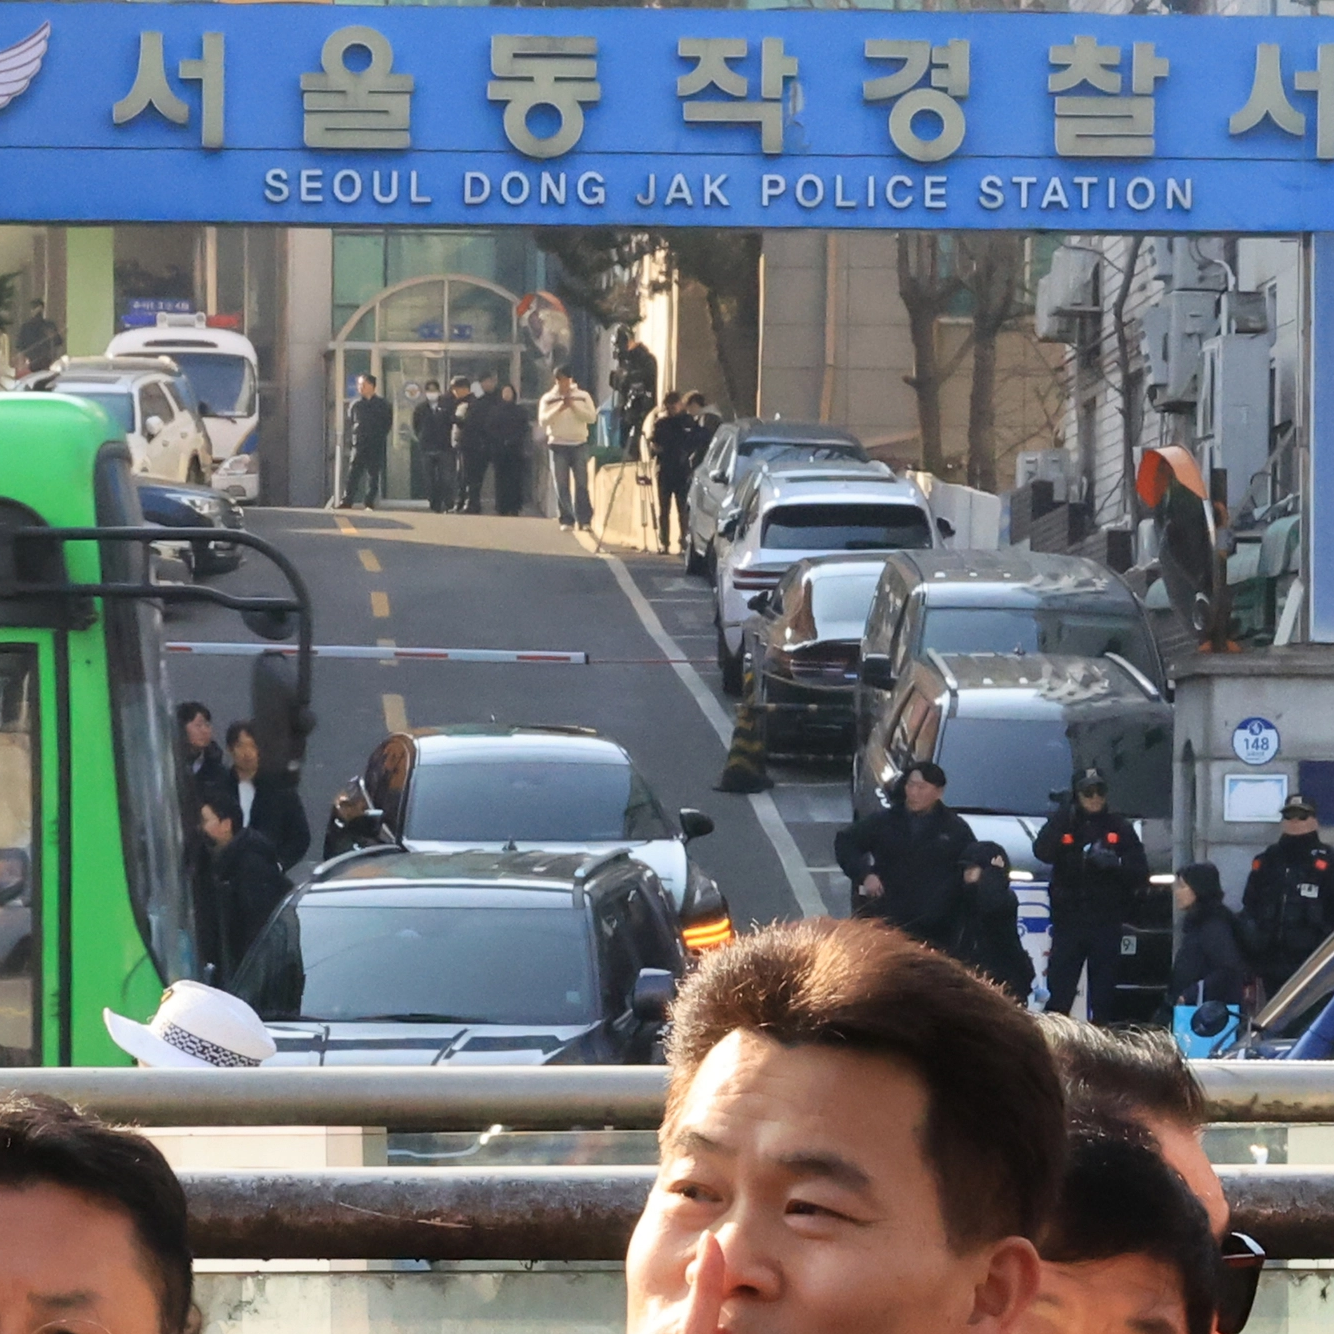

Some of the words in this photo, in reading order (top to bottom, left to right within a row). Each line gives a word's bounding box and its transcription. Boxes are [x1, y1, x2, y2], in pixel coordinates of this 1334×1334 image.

[264, 167, 431, 204] SEOUL
[463, 170, 606, 206] DONG
[635, 173, 730, 206] JAK
[761, 173, 948, 209] POLICE
[978, 175, 1193, 211] STATION
[1243, 737, 1270, 751] 148
